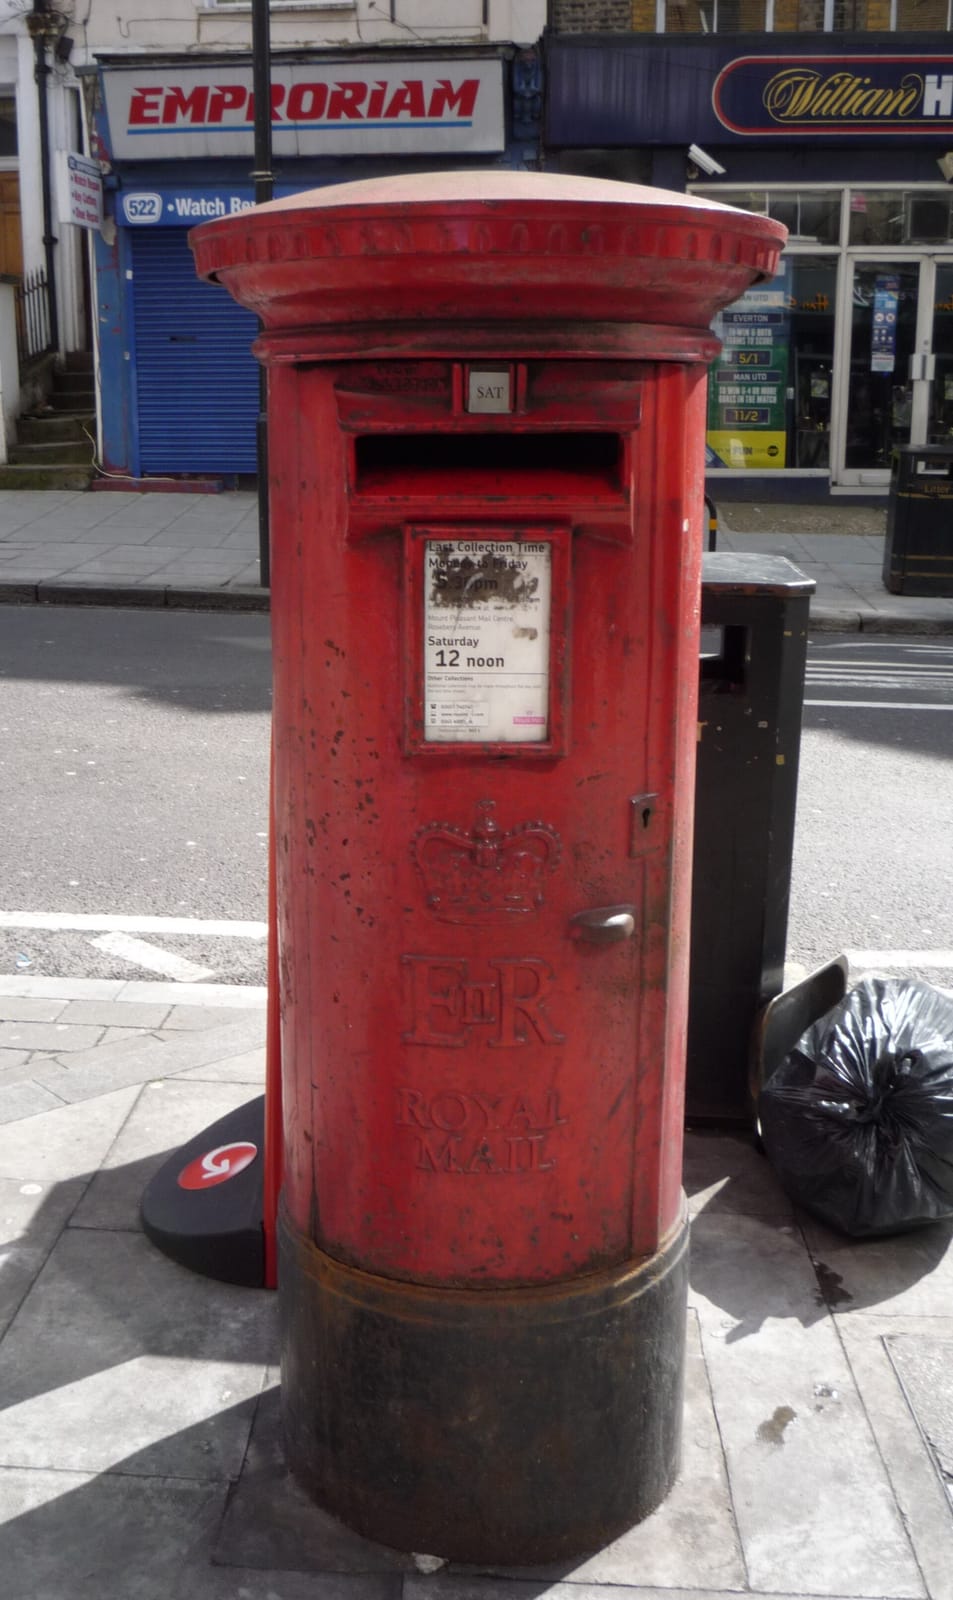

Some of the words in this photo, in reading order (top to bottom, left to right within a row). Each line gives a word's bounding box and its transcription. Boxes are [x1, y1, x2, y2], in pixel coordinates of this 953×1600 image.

[763, 69, 924, 122] William
[129, 200, 156, 216] 522
[175, 198, 225, 217] Watch
[733, 314, 769, 322] EVERTON
[739, 353, 759, 364] 5/1
[733, 373, 750, 381] MAN
[752, 373, 768, 381] UTD
[476, 386, 504, 400] SAT
[735, 410, 759, 422] 11/2
[429, 541, 453, 553] Last
[457, 541, 513, 553] Collection
[518, 542, 545, 553] Time
[428, 635, 480, 648] Saturday
[435, 649, 461, 668] 12
[466, 656, 505, 668] noon
[397, 1087, 569, 1131] ROYAL
[414, 1134, 557, 1175] MAIL
